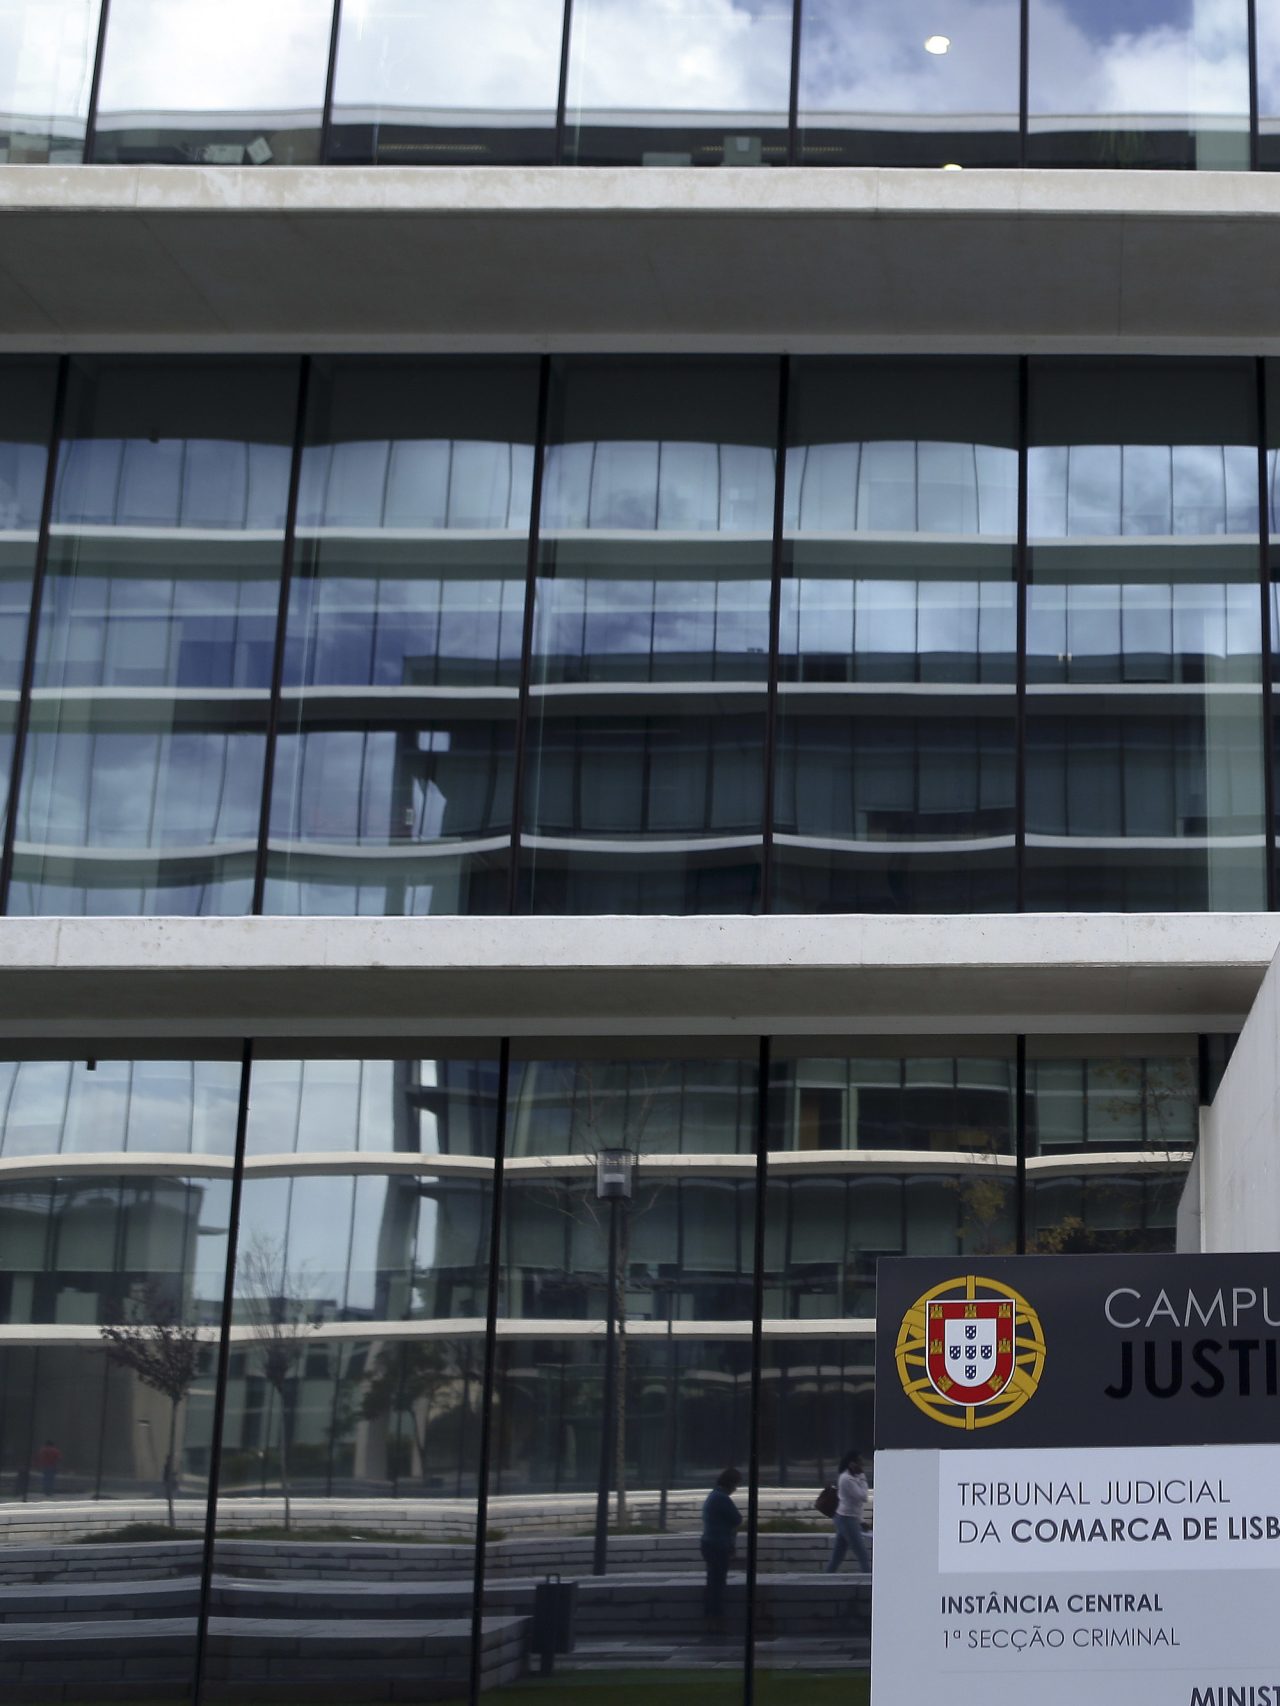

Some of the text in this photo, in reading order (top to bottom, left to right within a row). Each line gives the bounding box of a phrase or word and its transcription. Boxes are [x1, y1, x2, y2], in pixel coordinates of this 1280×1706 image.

[957, 1480, 1231, 1507] TRIBUNAL JUDICIAL
[958, 1519, 1001, 1544] DA
[1011, 1517, 1172, 1544] COMARCA
[1182, 1516, 1218, 1541] DE
[941, 1591, 1164, 1615] INSTÂNCIA CENTRAL
[967, 1625, 1065, 1653] SECÇÃO
[1072, 1626, 1181, 1647] CRIMINAL
